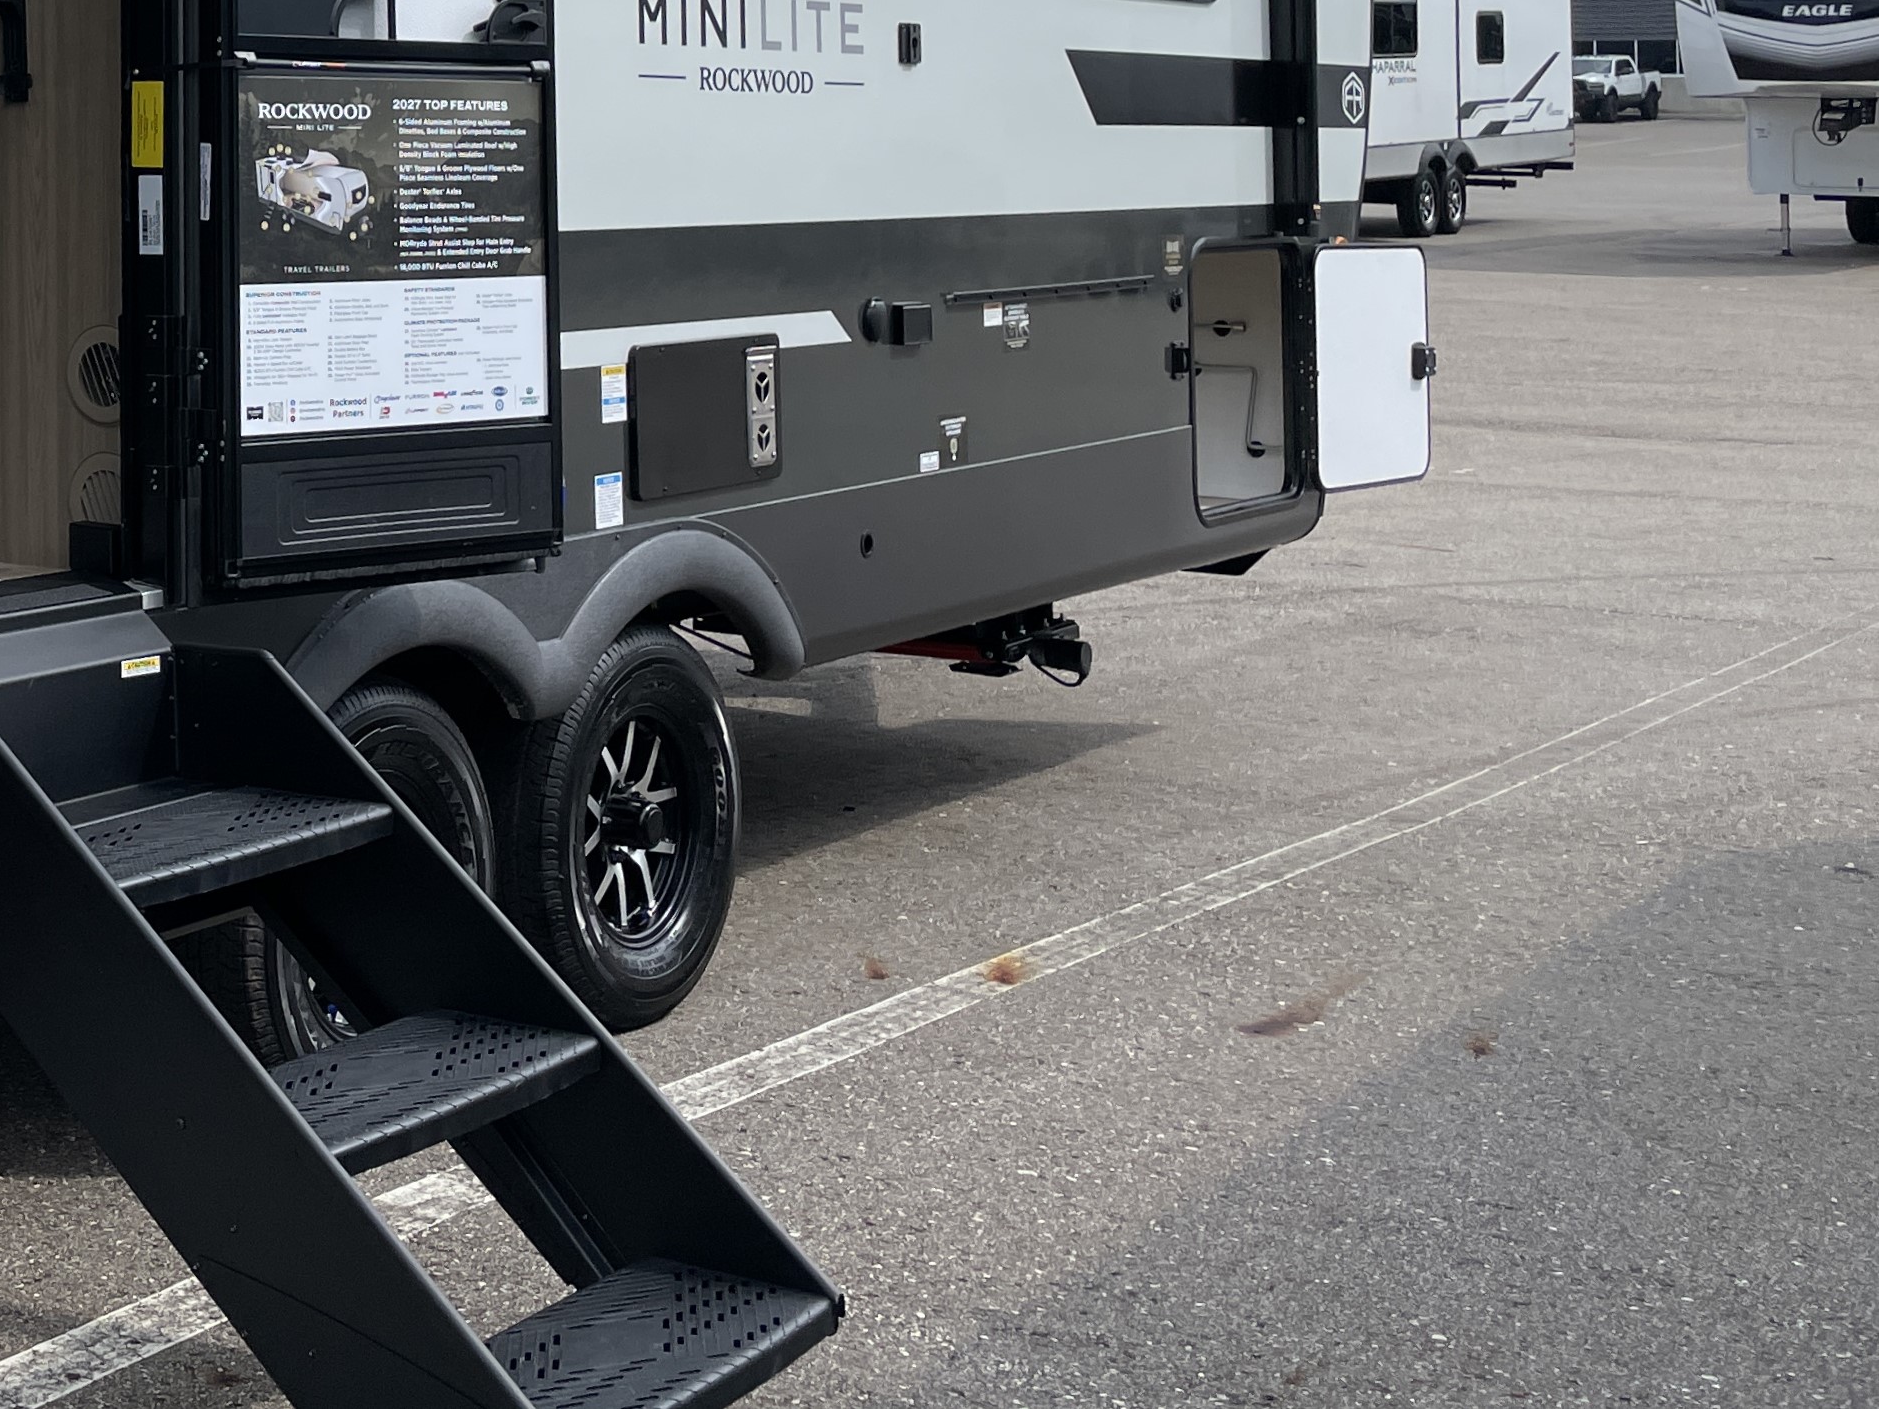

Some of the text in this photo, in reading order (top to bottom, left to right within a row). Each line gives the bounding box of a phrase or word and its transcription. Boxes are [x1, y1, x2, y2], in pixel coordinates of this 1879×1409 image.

[1782, 4, 1853, 17] EAGLE
[1372, 60, 1417, 73] HAPARRAL
[699, 67, 814, 94] ROCKWOOD
[392, 99, 508, 111] 2027 TOP FEATURES
[258, 103, 371, 120] ROCKWOOD
[283, 264, 350, 274] TRAVEL TRAILERS
[329, 397, 367, 407] Rockwood
[333, 409, 364, 418] Partners
